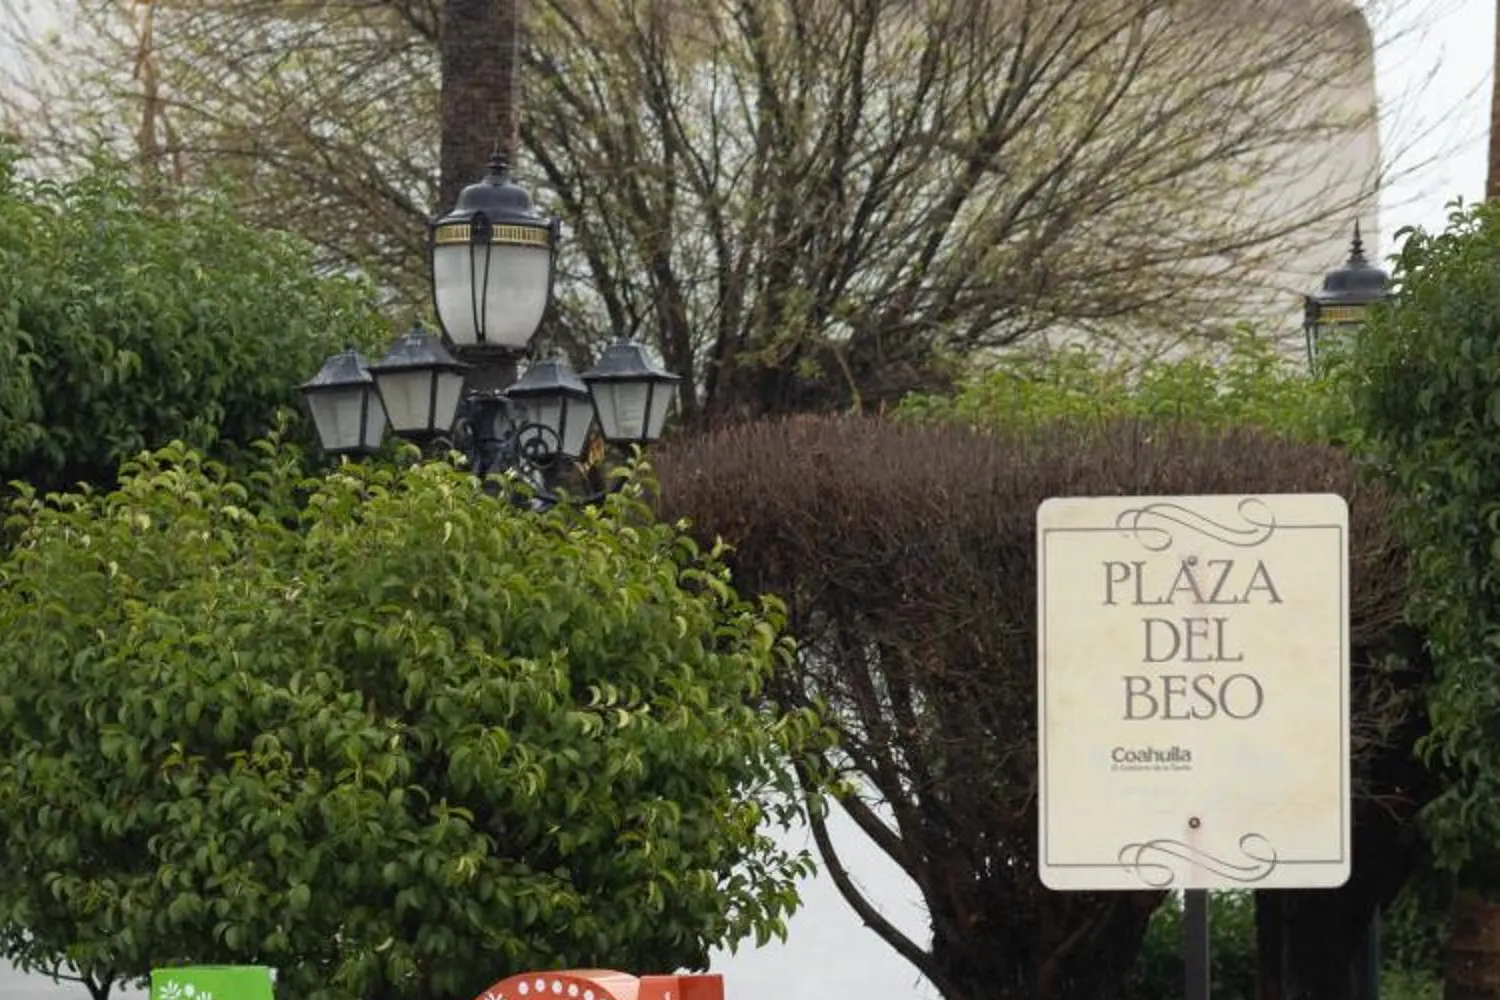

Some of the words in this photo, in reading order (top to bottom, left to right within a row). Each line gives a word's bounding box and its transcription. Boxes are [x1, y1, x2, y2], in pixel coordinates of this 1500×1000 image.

[1102, 559, 1283, 606] PLAZA
[1142, 617, 1244, 663] DEL
[1122, 673, 1264, 720] BESO
